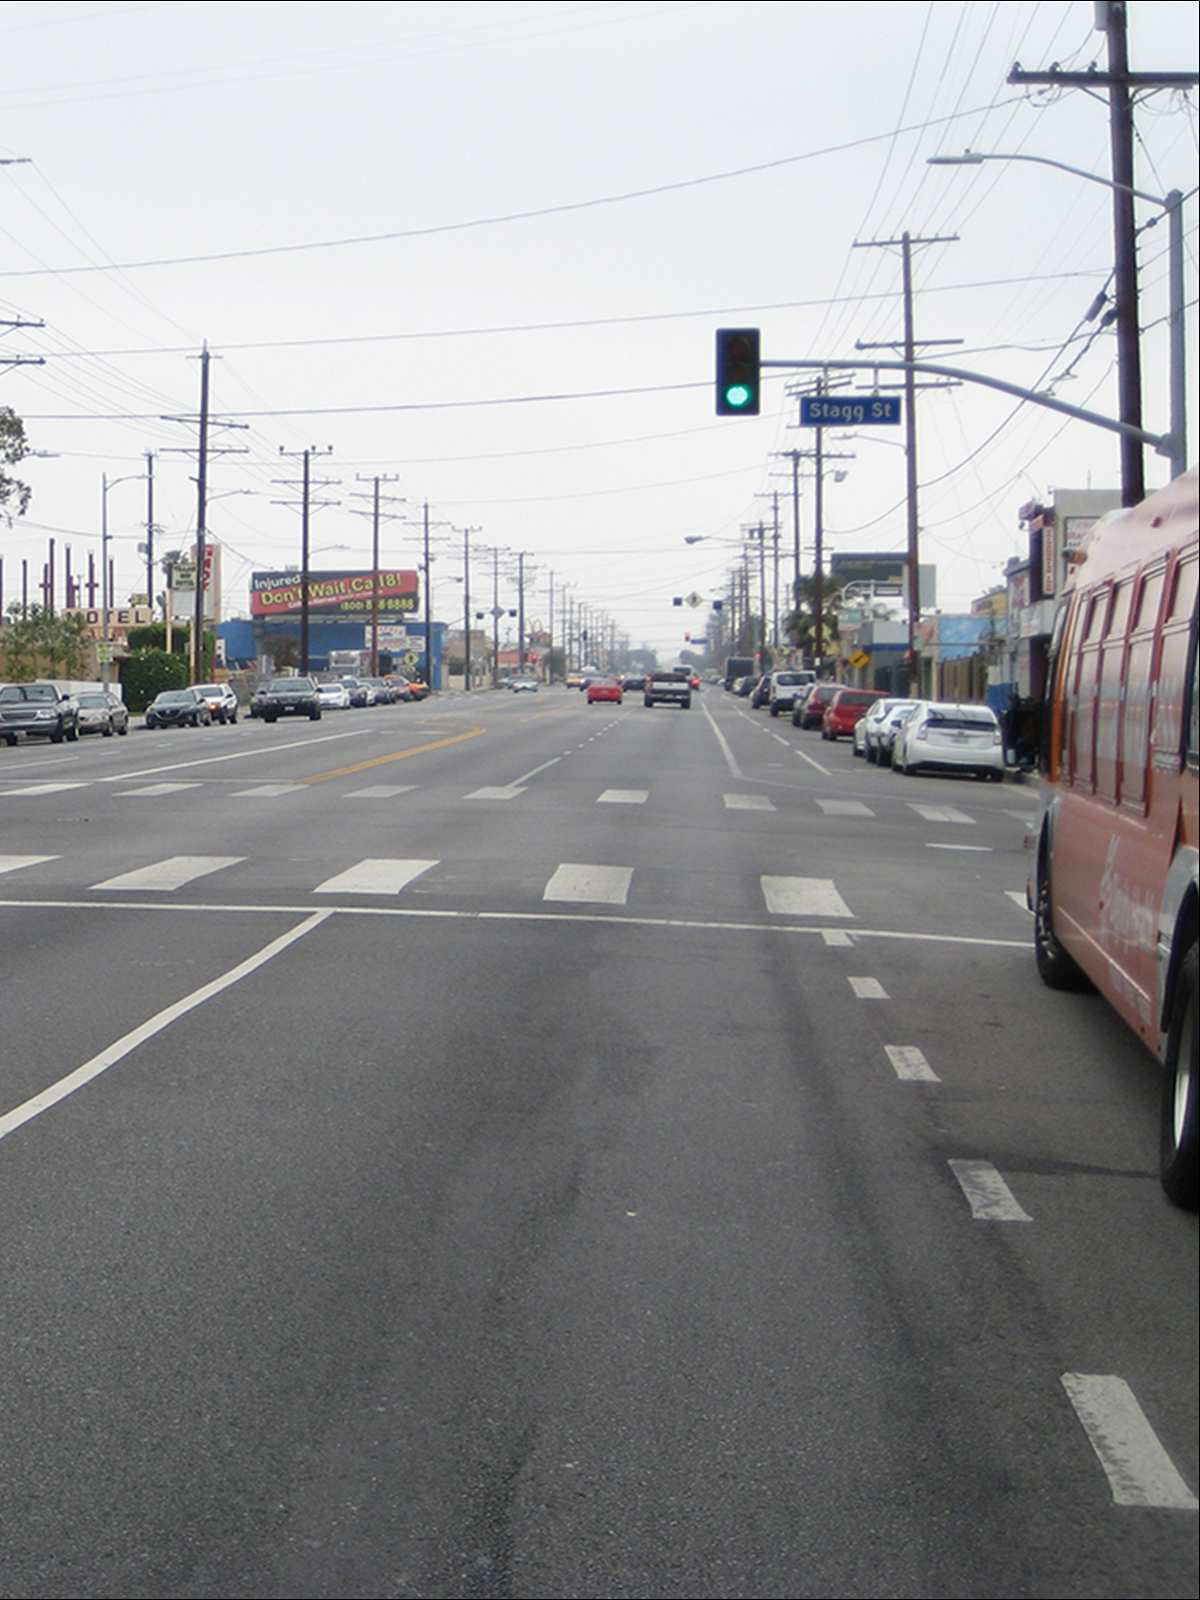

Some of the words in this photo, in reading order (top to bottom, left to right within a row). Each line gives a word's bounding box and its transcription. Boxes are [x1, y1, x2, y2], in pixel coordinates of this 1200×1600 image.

[809, 403, 864, 422] Stagg
[872, 403, 891, 417] St
[254, 574, 304, 590] Injured
[261, 587, 303, 605] Don't
[351, 575, 384, 591] Cal
[365, 599, 414, 610] 88-8888
